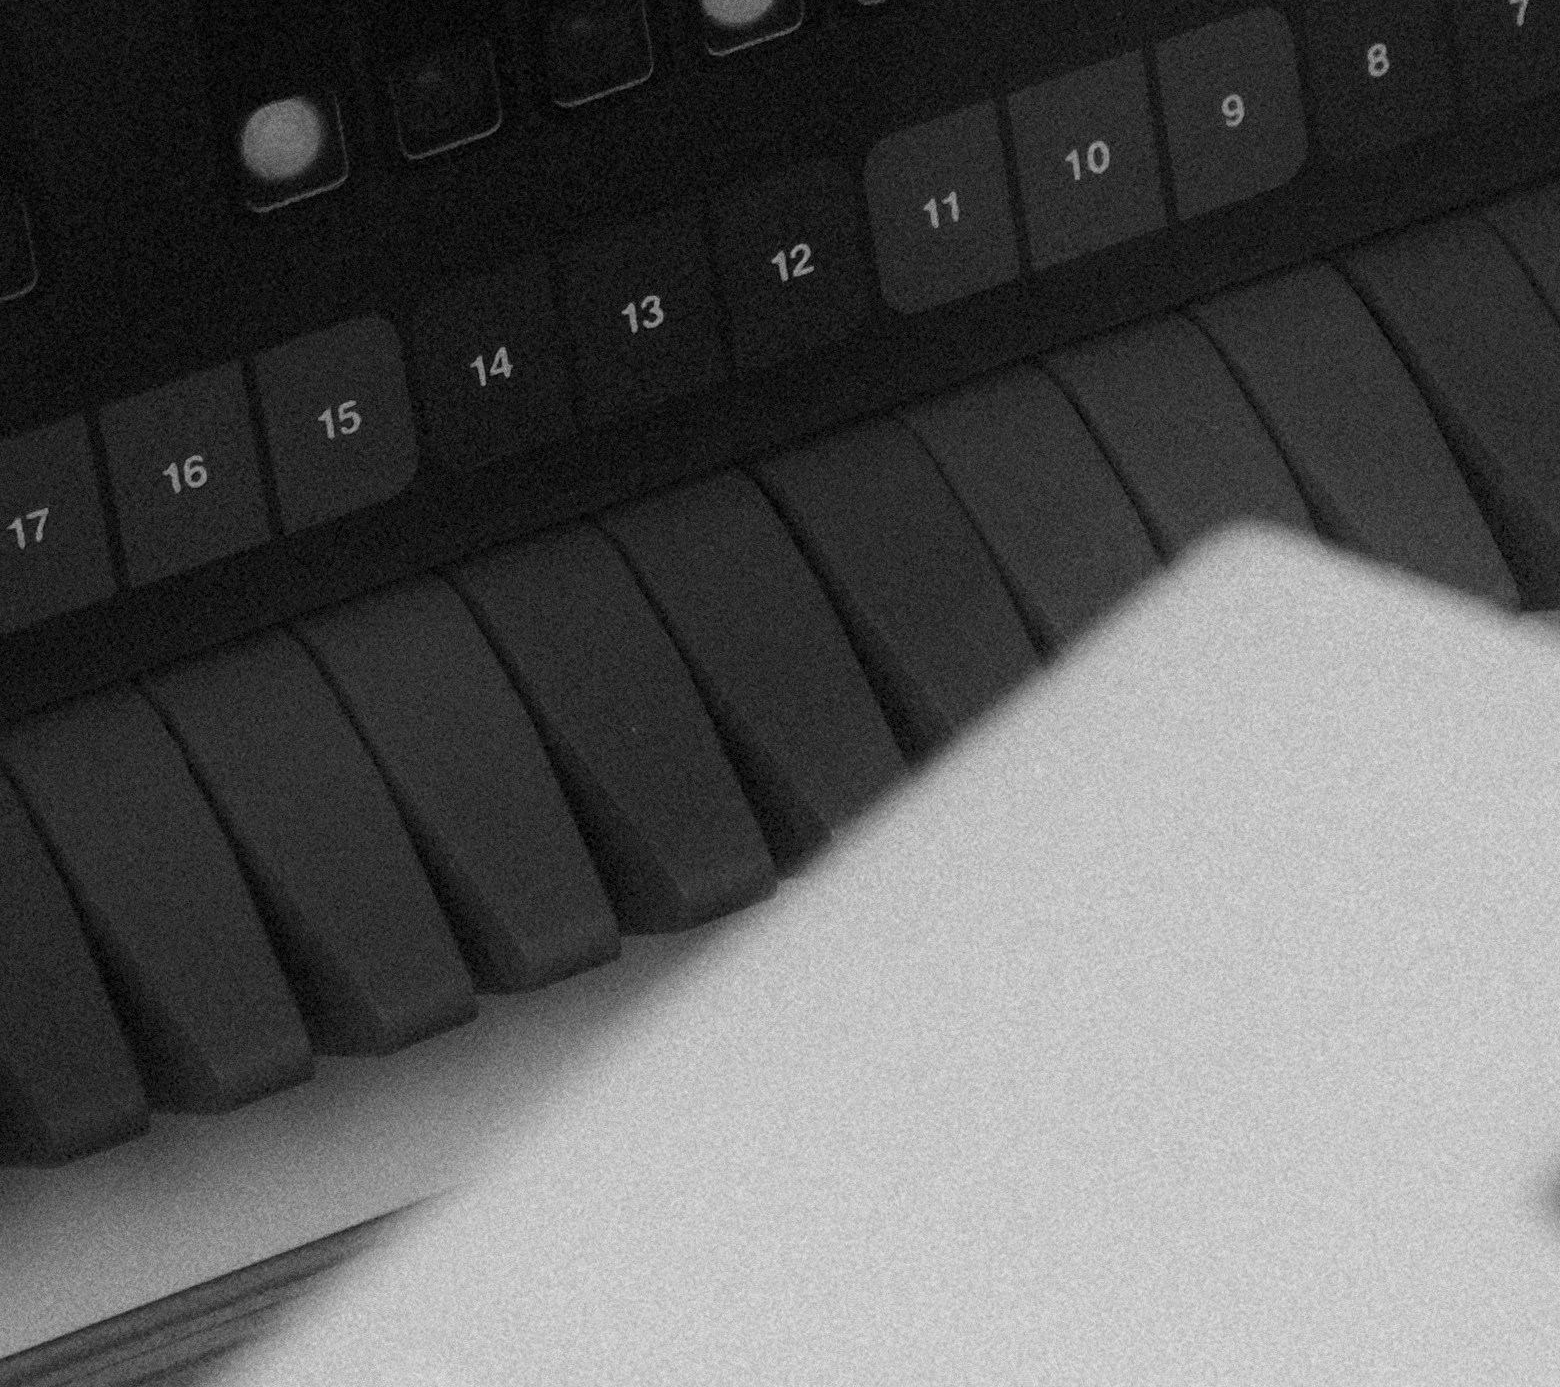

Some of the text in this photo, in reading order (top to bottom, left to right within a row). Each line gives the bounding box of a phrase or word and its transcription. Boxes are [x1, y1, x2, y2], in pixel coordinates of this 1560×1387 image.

[8, 507, 50, 549] 17
[163, 454, 209, 494] 16
[318, 399, 362, 440] 15
[470, 346, 513, 387] 14
[621, 294, 665, 333] 13
[770, 242, 815, 282] 12
[923, 191, 960, 229] 11
[1065, 139, 1111, 181] 10
[1220, 93, 1246, 128] 9
[1366, 42, 1391, 78] 8
